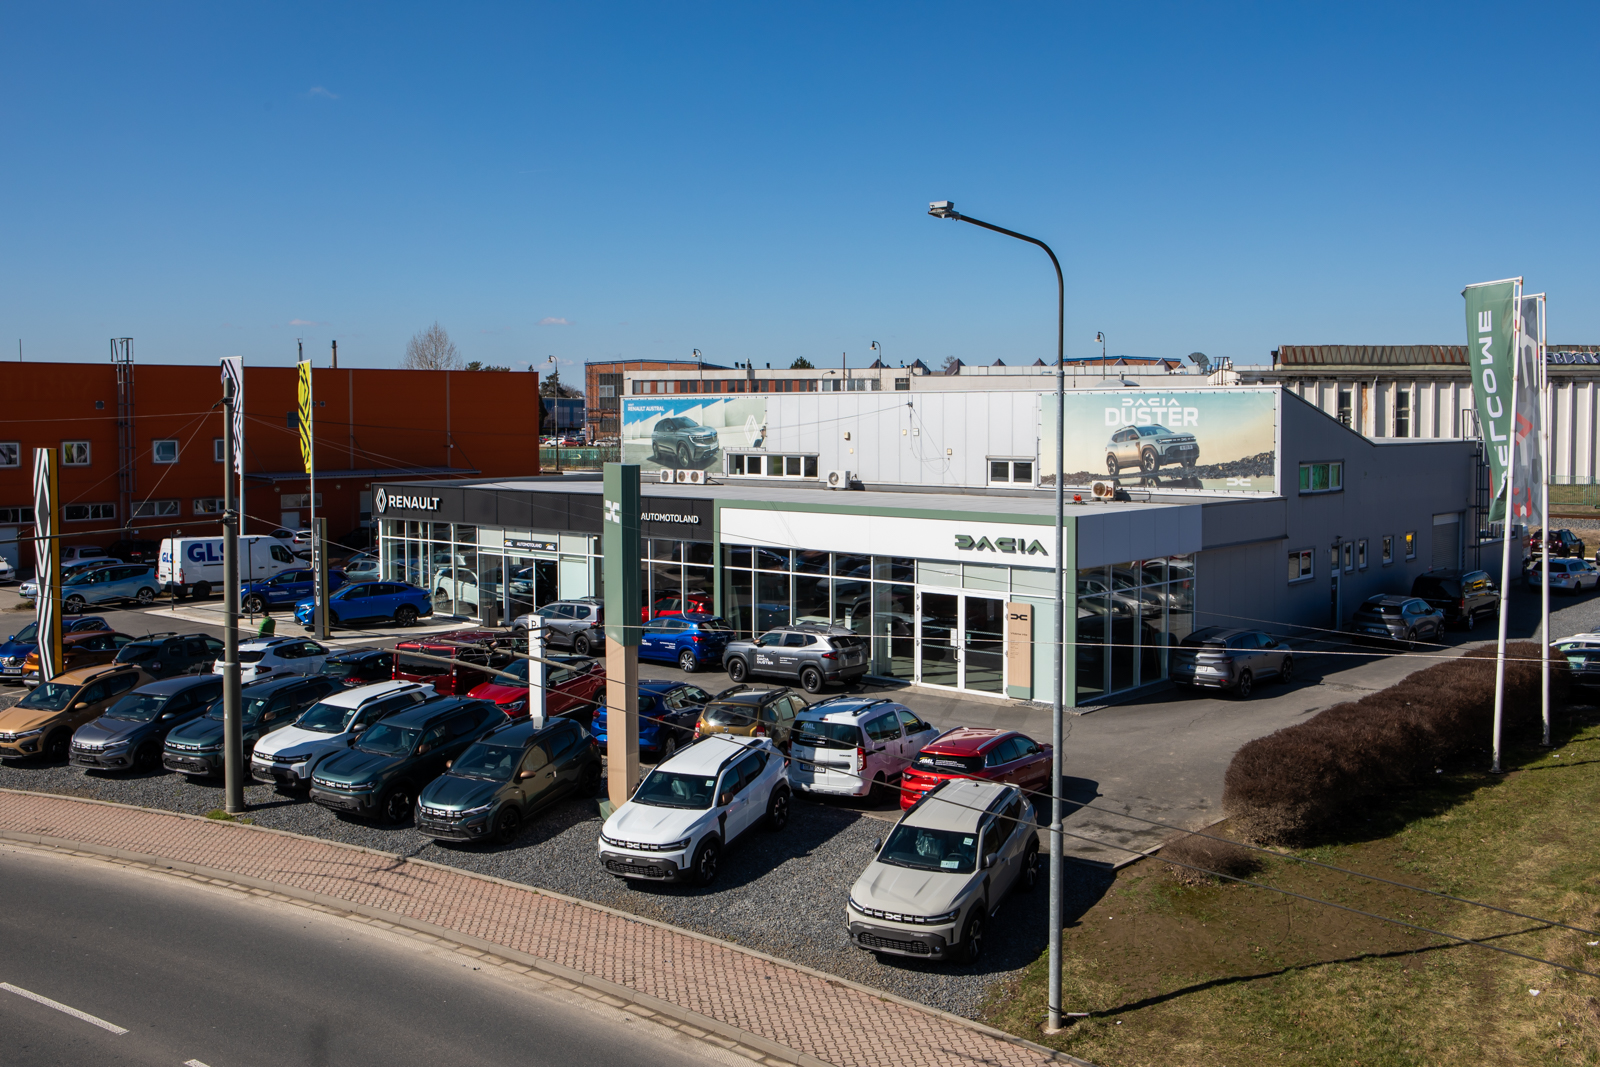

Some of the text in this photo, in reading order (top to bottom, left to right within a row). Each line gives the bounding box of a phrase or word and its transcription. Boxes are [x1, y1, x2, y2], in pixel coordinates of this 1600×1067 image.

[1122, 398, 1180, 406] DACIA
[1478, 310, 1510, 499] ELCOME
[1105, 407, 1199, 426] DUSTER
[388, 495, 440, 510] RENAULT
[641, 513, 699, 524] AUTOMOTOLAND
[954, 534, 1049, 556] DACIA
